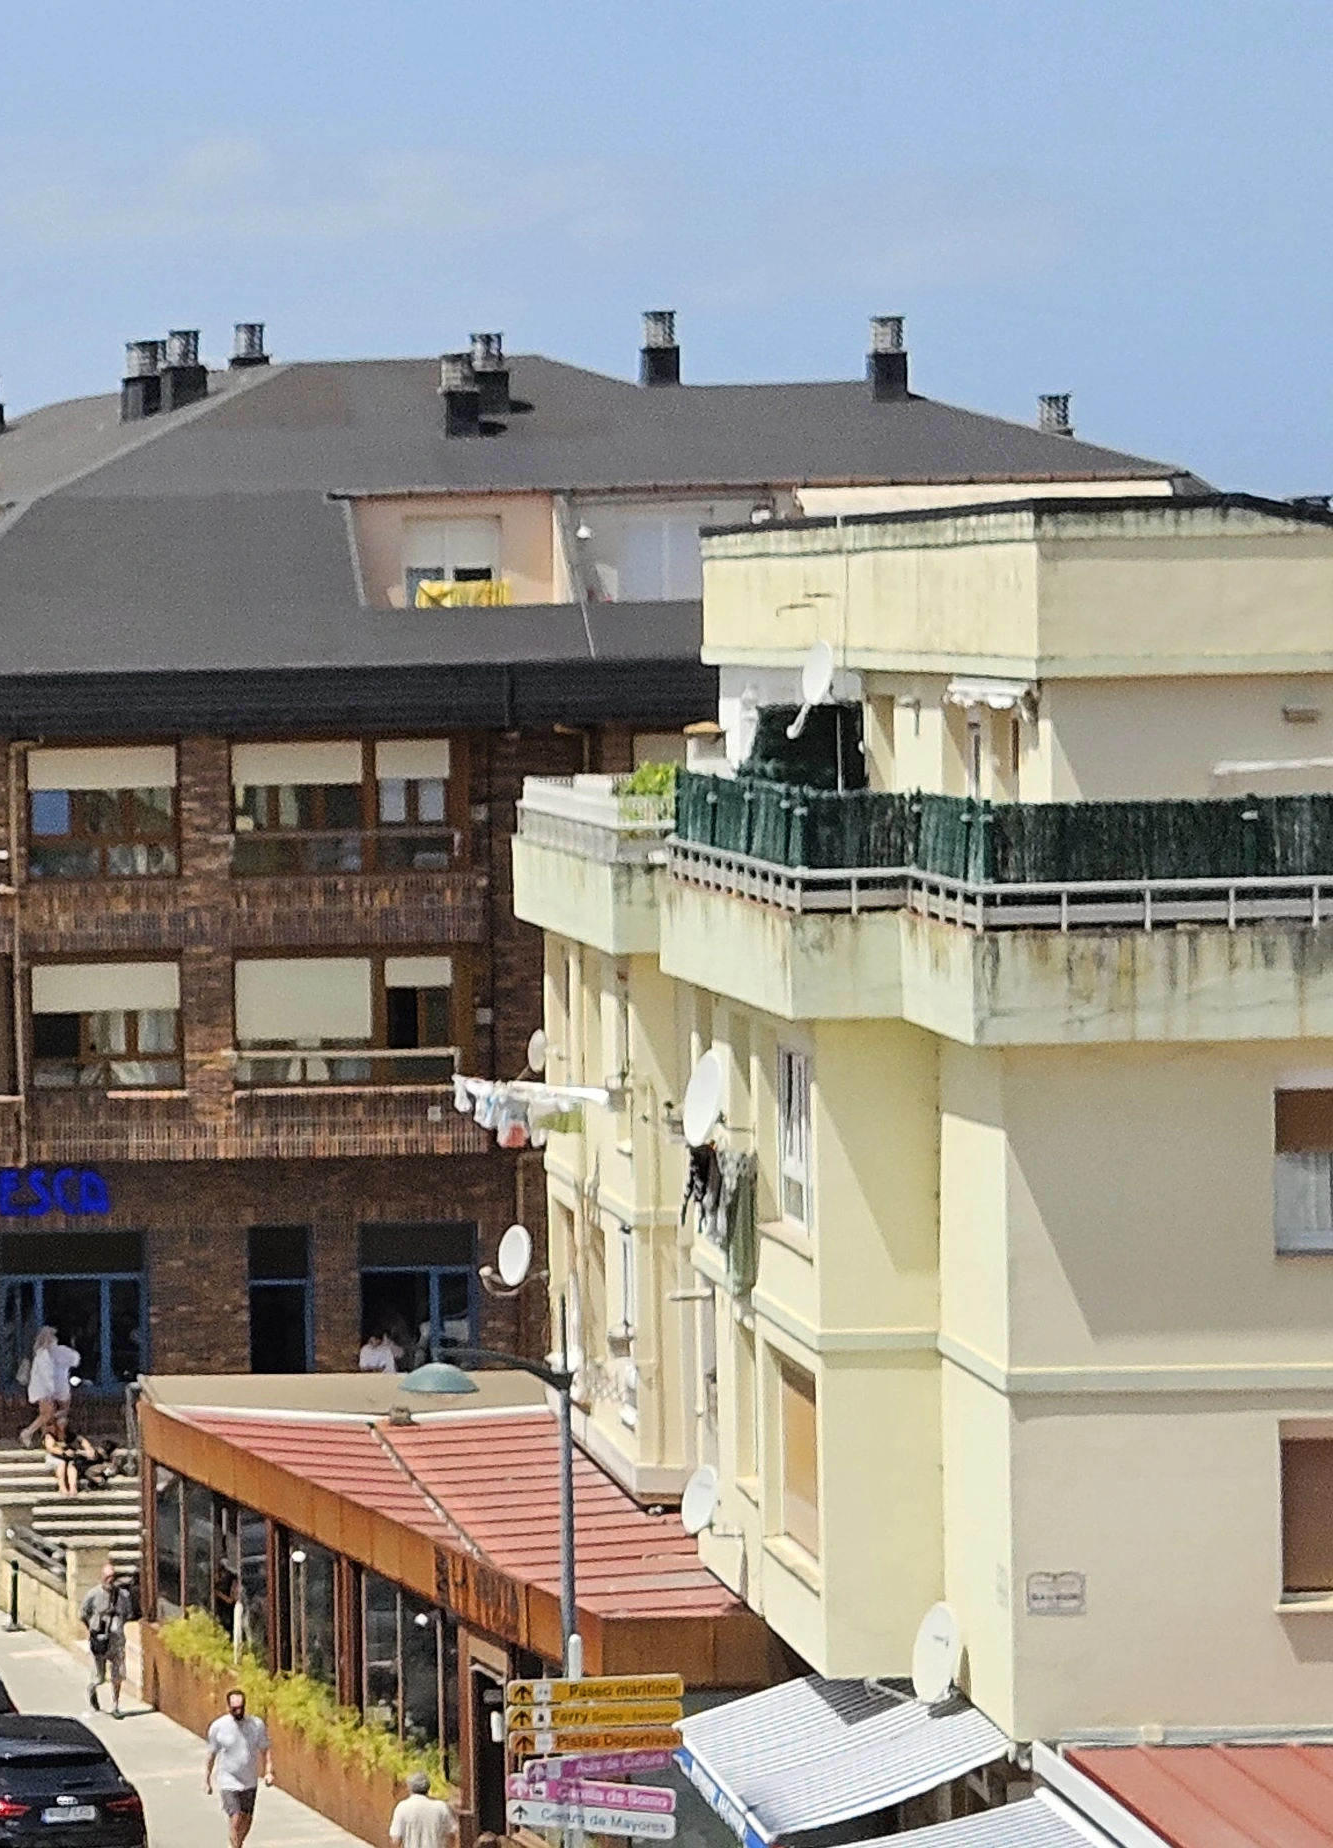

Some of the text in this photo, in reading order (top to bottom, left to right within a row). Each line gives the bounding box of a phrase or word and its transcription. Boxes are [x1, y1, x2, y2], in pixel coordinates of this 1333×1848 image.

[569, 1684, 612, 1698] Paseo
[551, 1710, 588, 1723] Ferry
[557, 1731, 679, 1747] Pistas Deportivas
[590, 1814, 606, 1826] de
[610, 1815, 667, 1834] Mayores
